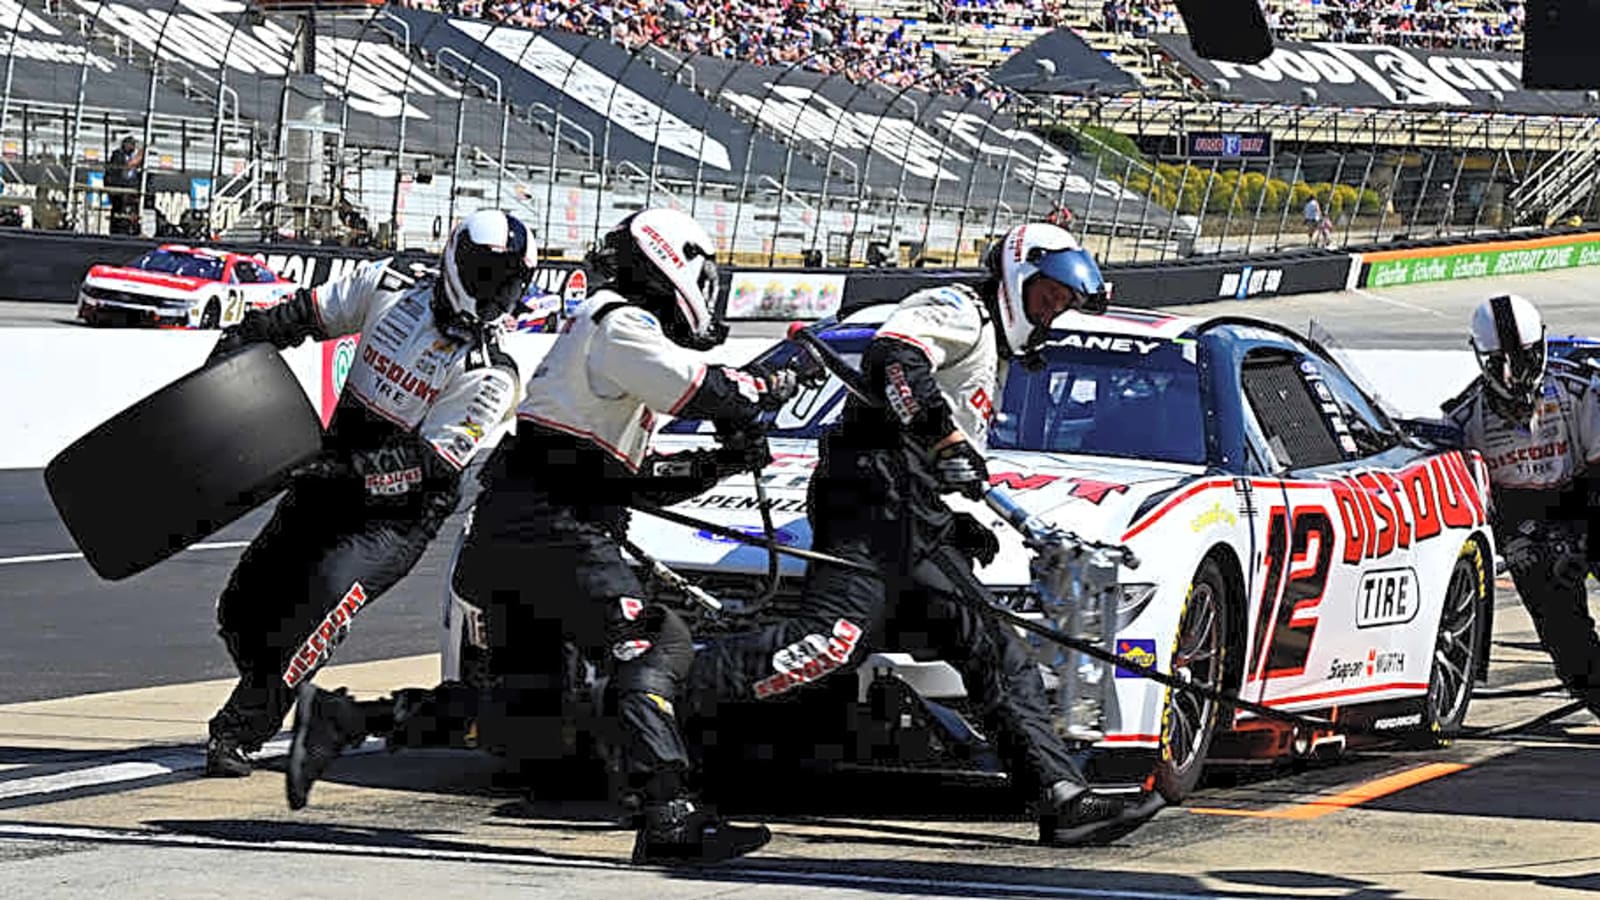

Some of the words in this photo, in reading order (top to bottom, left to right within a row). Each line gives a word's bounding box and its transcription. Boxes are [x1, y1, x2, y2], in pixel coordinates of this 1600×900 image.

[223, 288, 244, 322] 21
[375, 376, 407, 405] TRE
[1247, 505, 1336, 682] 12
[1362, 575, 1410, 620] TIRE
[283, 579, 367, 688] DISCOUNT
